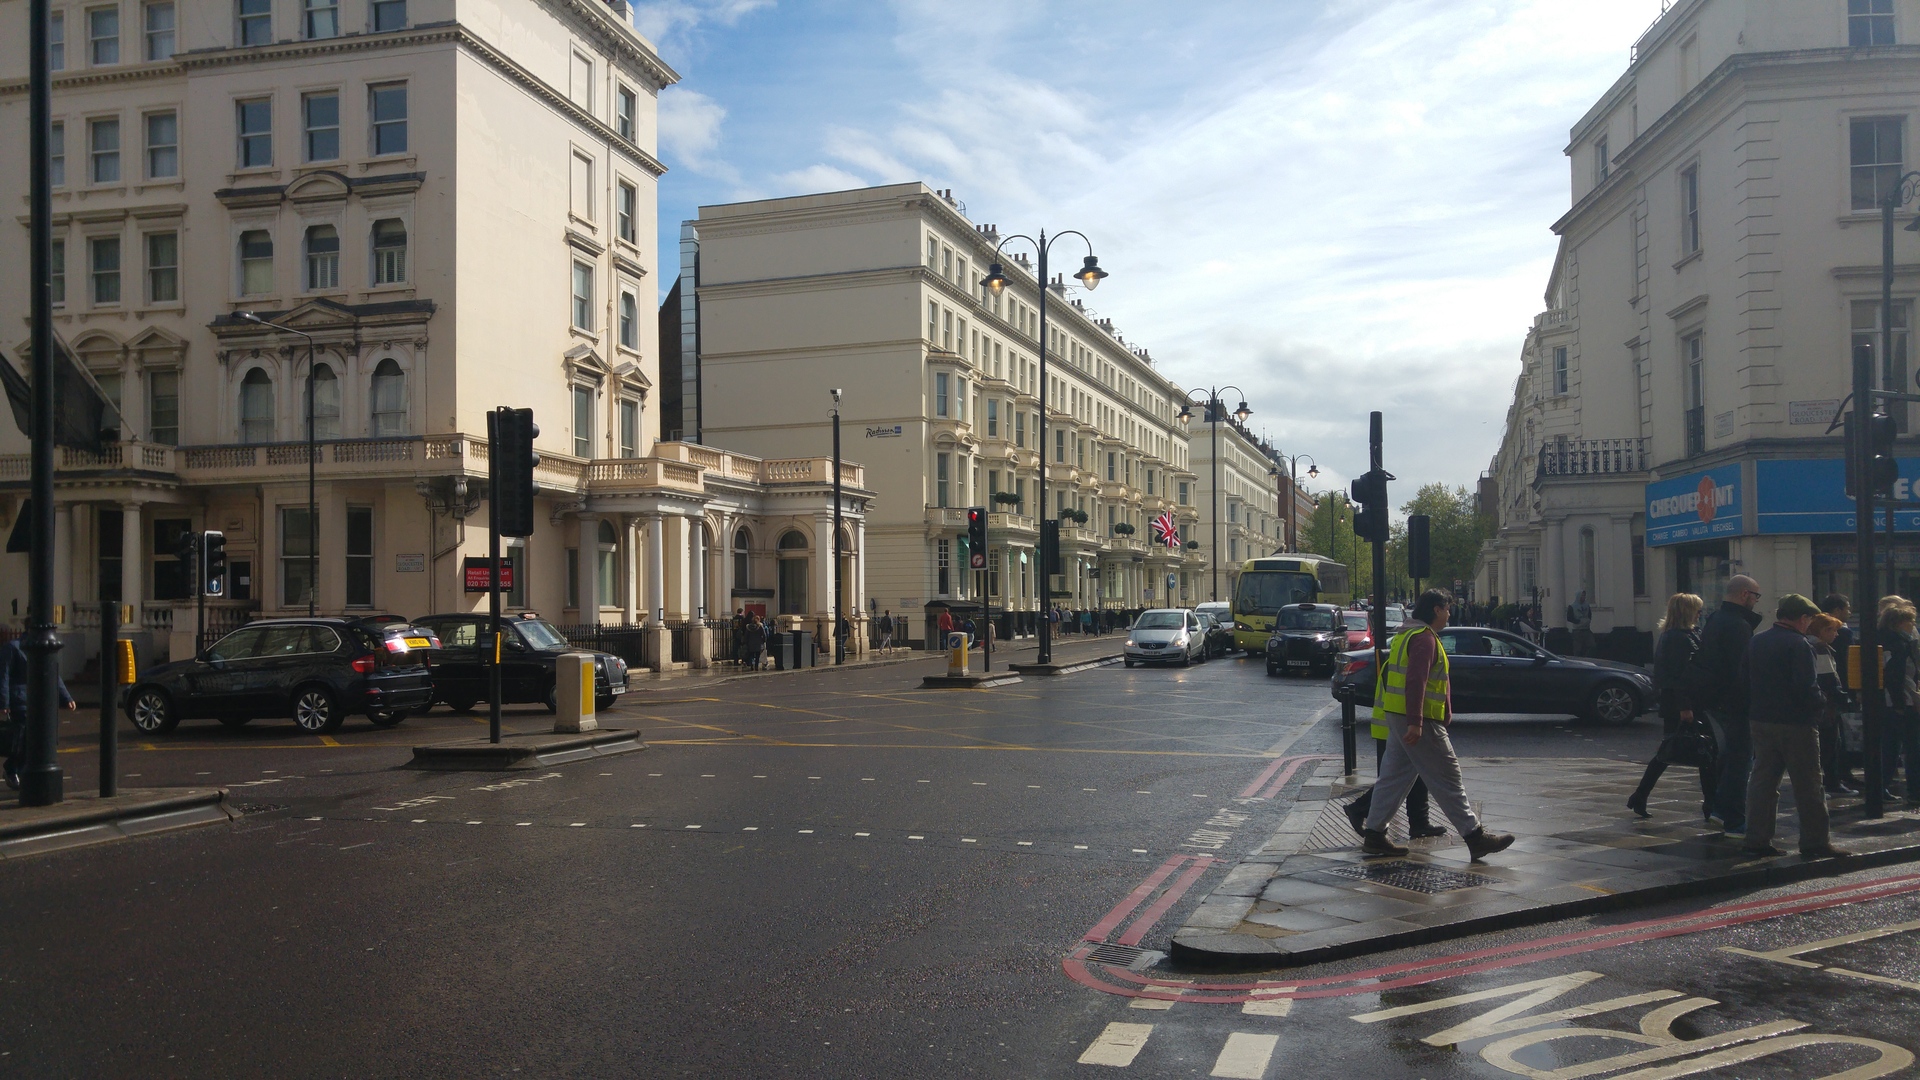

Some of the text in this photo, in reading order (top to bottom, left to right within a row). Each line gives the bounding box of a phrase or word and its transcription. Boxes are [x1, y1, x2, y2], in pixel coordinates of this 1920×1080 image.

[1792, 409, 1837, 417] GLOUCESTER
[1652, 522, 1734, 541] CHANGE CAMBIO VALUTA WECHSEL
